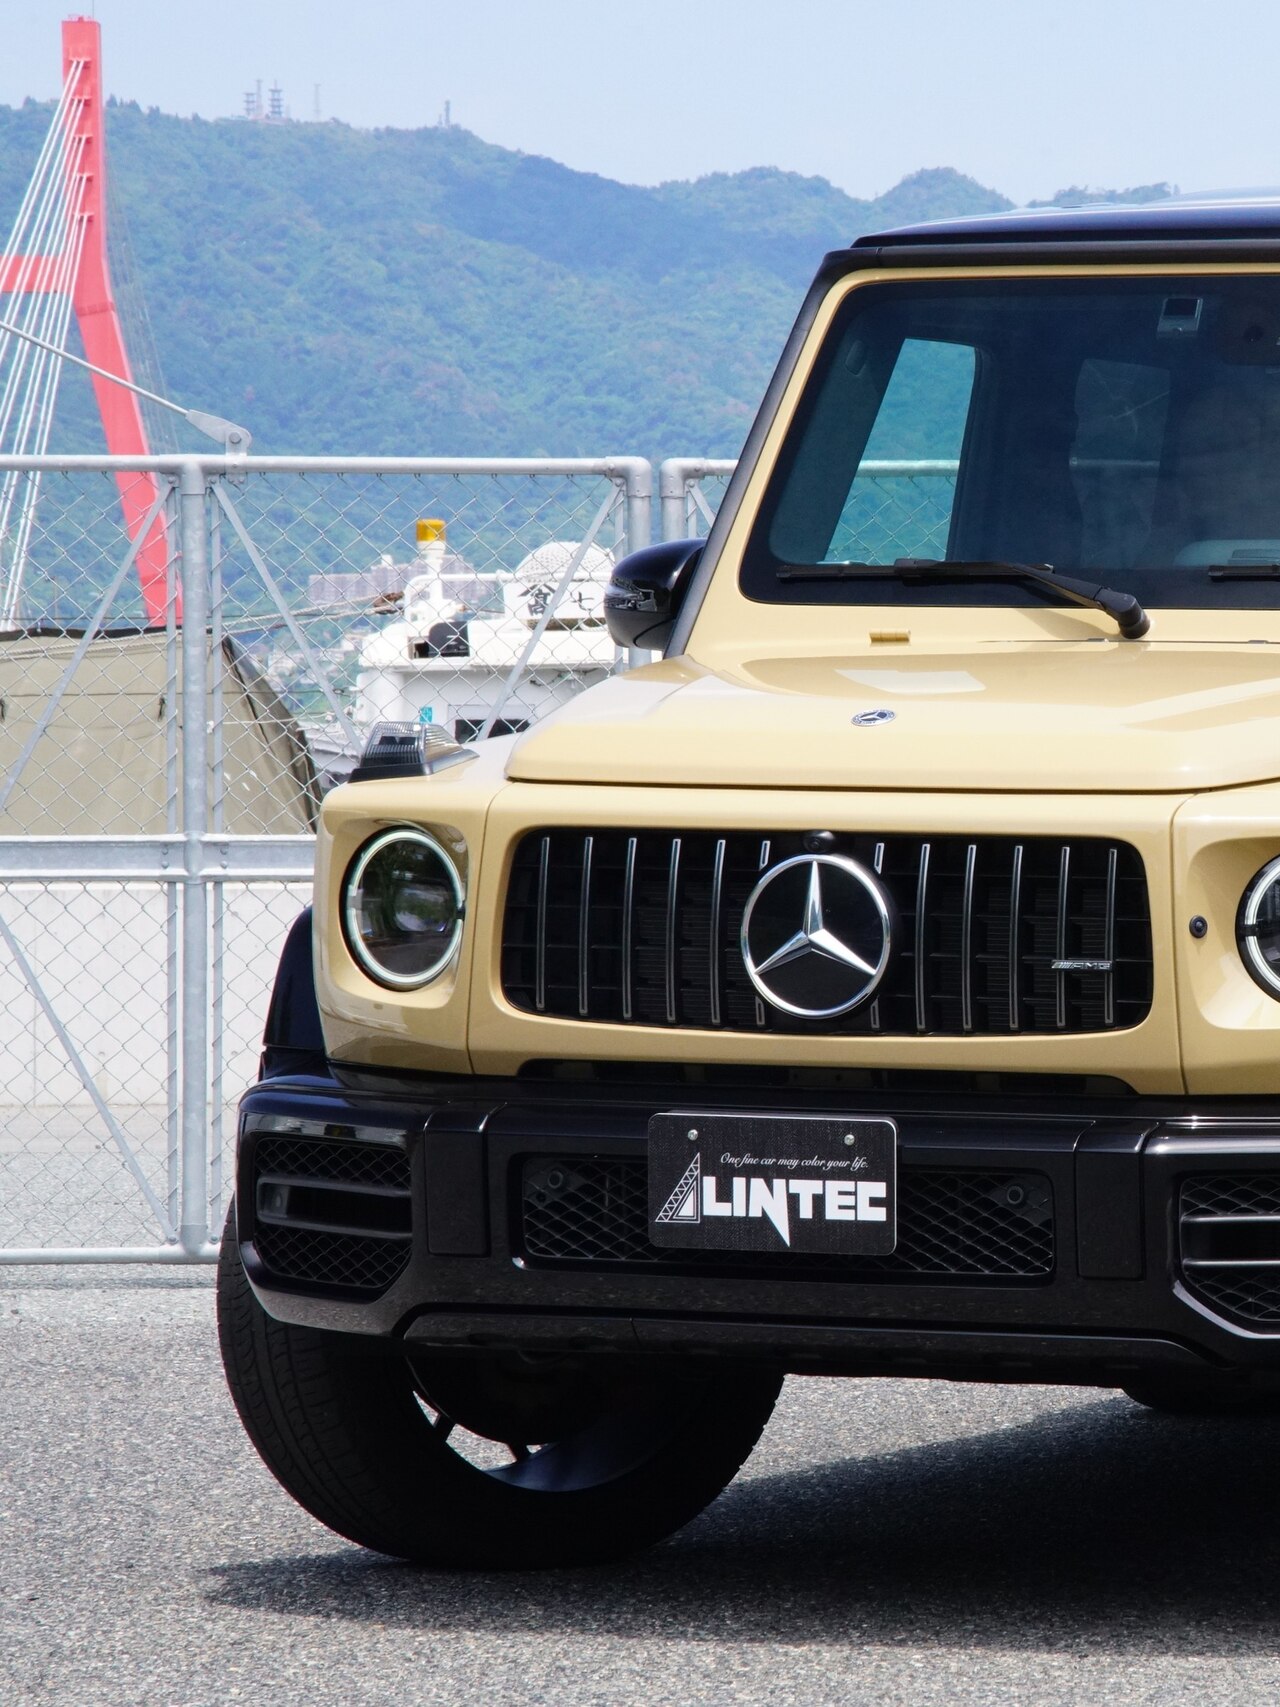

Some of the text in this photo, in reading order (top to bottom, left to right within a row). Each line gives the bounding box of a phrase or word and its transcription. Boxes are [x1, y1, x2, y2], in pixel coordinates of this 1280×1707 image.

[720, 1152, 869, 1171] One fine car may color your life.
